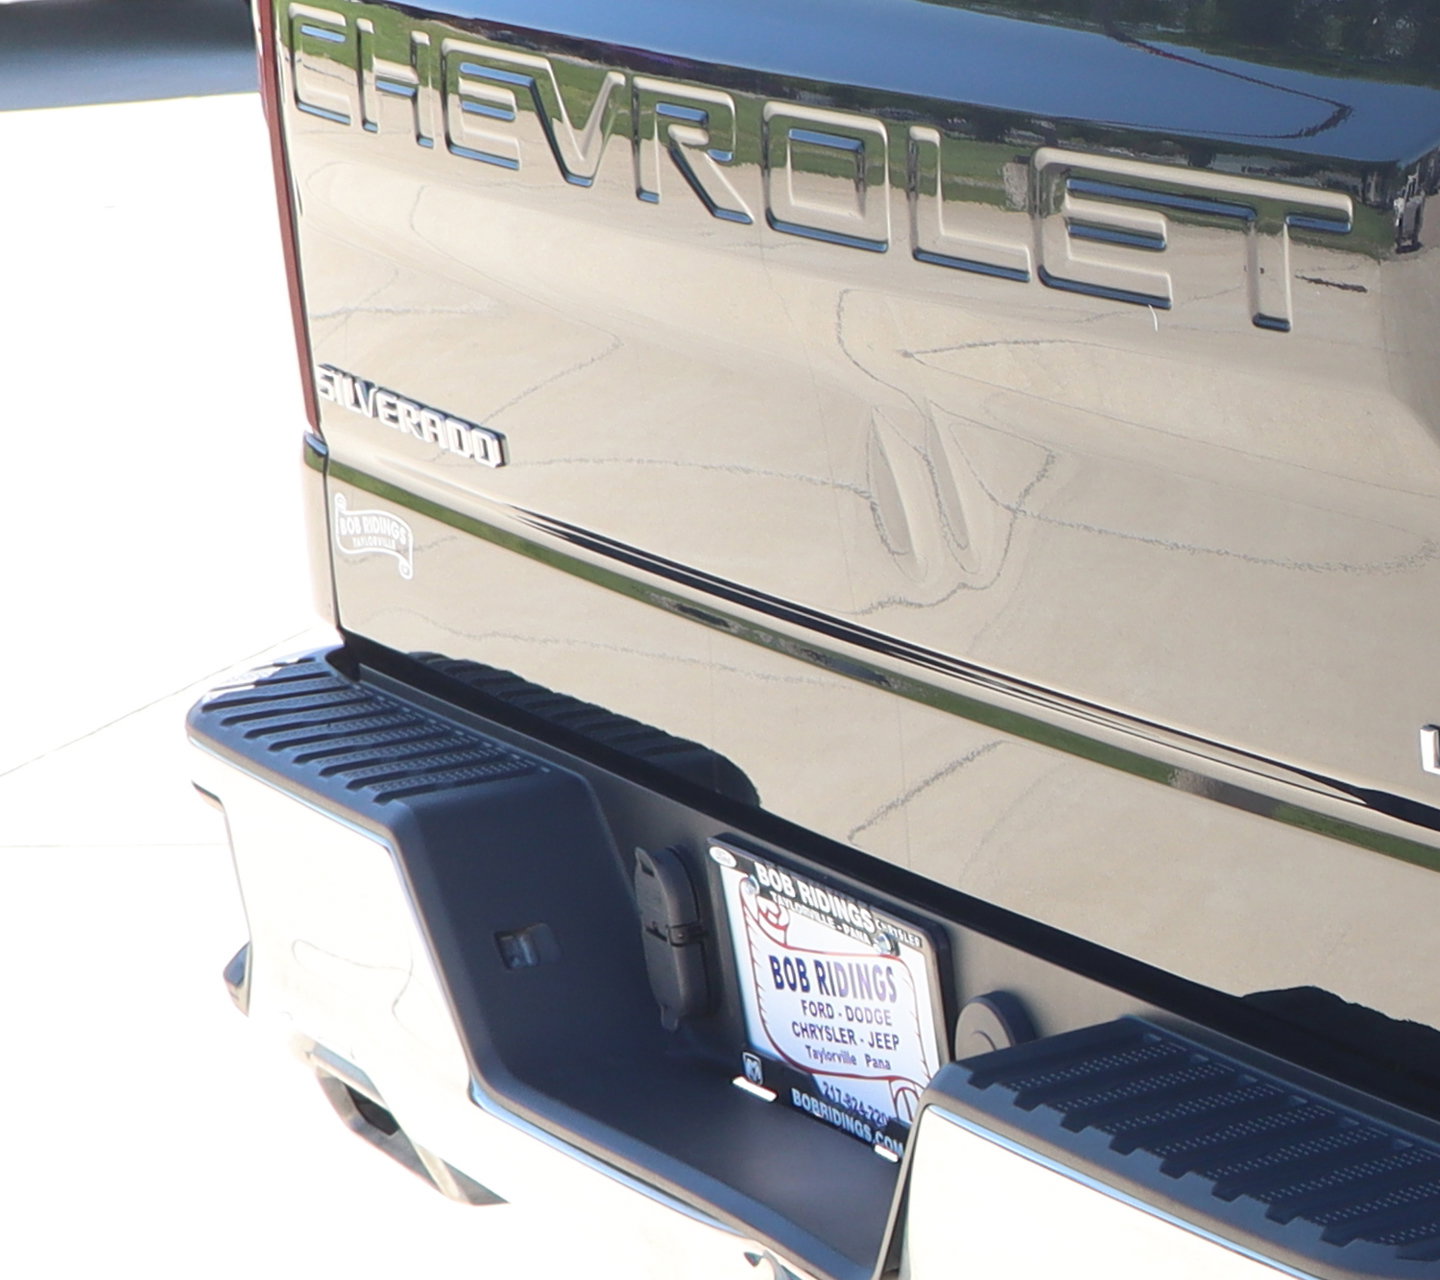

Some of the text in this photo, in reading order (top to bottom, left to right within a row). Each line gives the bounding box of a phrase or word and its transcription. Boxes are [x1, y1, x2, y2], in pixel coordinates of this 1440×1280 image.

[288, 1, 1354, 332] CHEVROLET
[316, 365, 507, 469] SILVERADO
[340, 515, 406, 545] BOB RIDINGS
[754, 861, 796, 898] BOB
[797, 880, 876, 933] RIDINGS
[769, 954, 898, 1004] BOB RIDINGS
[801, 999, 835, 1020] FORD
[844, 1004, 893, 1027] DODGE
[791, 1021, 858, 1046] CHRYSLER
[868, 1032, 900, 1051] JEEP
[805, 1044, 892, 1070] Taylorville Pana
